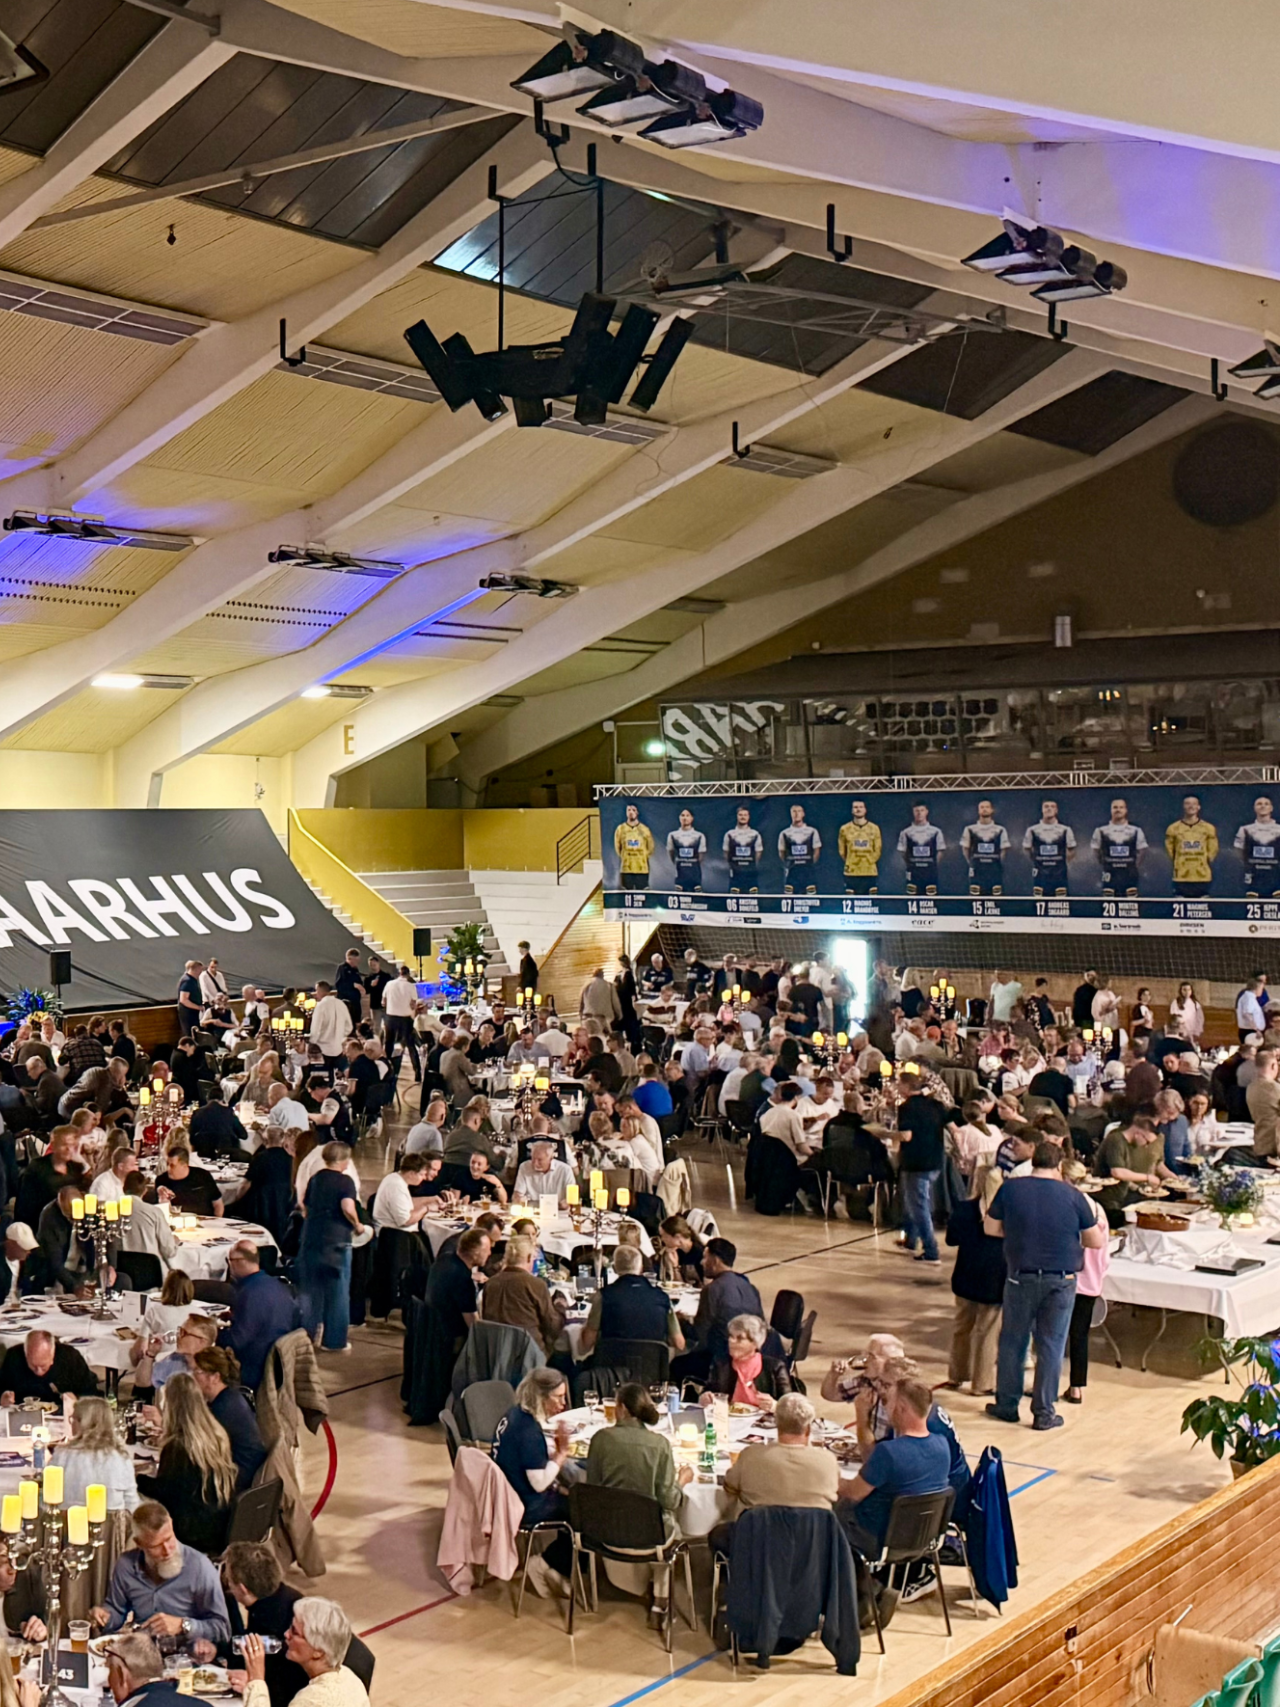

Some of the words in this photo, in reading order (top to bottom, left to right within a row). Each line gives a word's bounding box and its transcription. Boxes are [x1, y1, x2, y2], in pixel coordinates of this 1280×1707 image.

[344, 724, 354, 755] E
[624, 895, 632, 907] 01
[667, 896, 679, 908] 03
[726, 899, 738, 911] 06
[781, 899, 792, 912] 07
[842, 900, 853, 913] 12
[907, 901, 918, 914] 14
[972, 901, 983, 914] 15
[1036, 902, 1046, 915] 17
[1102, 903, 1116, 916] 20
[1172, 903, 1185, 917] 21
[1246, 904, 1261, 918] 25
[58, 1668, 74, 1680] 43
